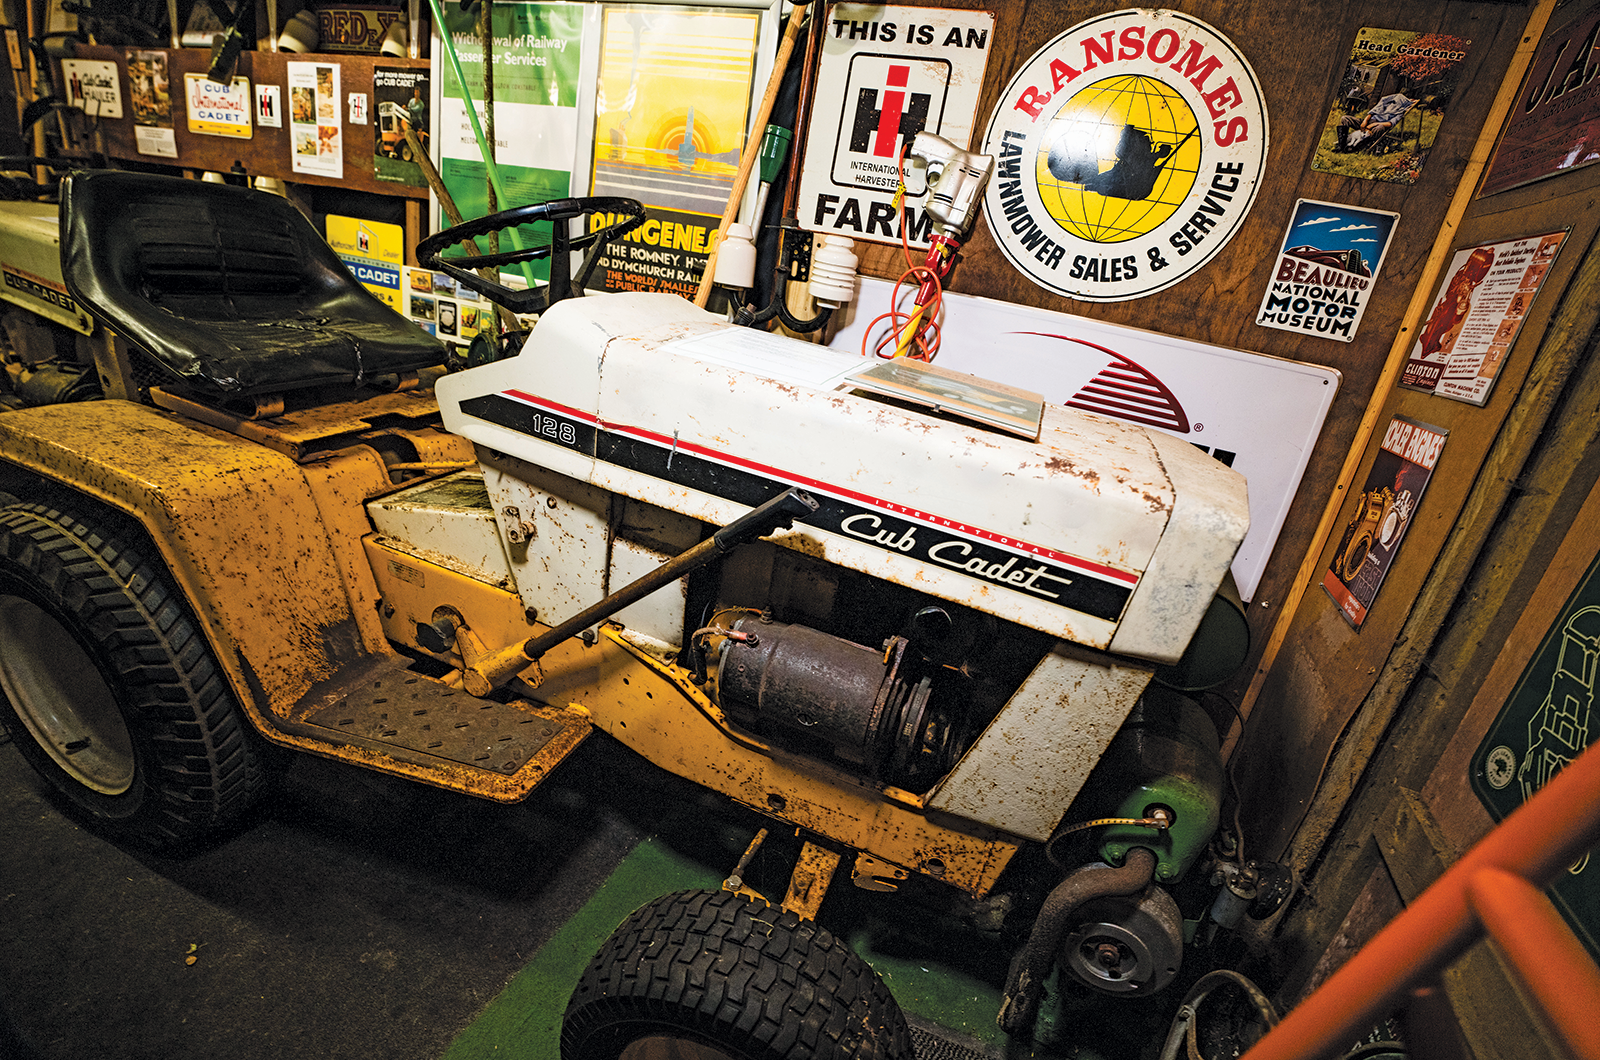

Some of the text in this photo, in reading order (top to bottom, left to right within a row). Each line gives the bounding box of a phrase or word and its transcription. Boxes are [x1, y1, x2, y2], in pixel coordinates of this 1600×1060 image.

[514, 34, 526, 47] of
[527, 34, 567, 53] Railway
[833, 19, 988, 50] THIS IS AN
[504, 52, 547, 66] Services
[1357, 39, 1465, 62] Head Gardener
[204, 84, 230, 93] CUB
[1013, 26, 1249, 149] RANSOMES
[198, 111, 240, 121] CADET
[850, 160, 911, 178] INTERNATIONAL
[997, 129, 1244, 283] LAWNMOWER SALES & SERVICE
[383, 249, 400, 259] Dealer
[606, 243, 627, 258] THE
[358, 267, 399, 285] CADET
[597, 257, 610, 268] ND
[611, 259, 676, 279] DYMCHURCH
[1276, 256, 1369, 291] BEAULIEU
[607, 269, 623, 280] THE
[660, 279, 700, 294] SMALLES
[616, 280, 646, 293] PUBLIC
[33, 284, 74, 310] CADET
[1265, 292, 1357, 319] MOTOR
[1272, 282, 1360, 307] NATIONAL
[1262, 311, 1354, 337] MUSEUM
[1405, 363, 1440, 380] CLINTON
[533, 413, 576, 445] 128
[1404, 428, 1445, 468] ENGINES
[875, 499, 1055, 558] INTERNATIONAL
[840, 513, 1073, 599] Cub Cadet
